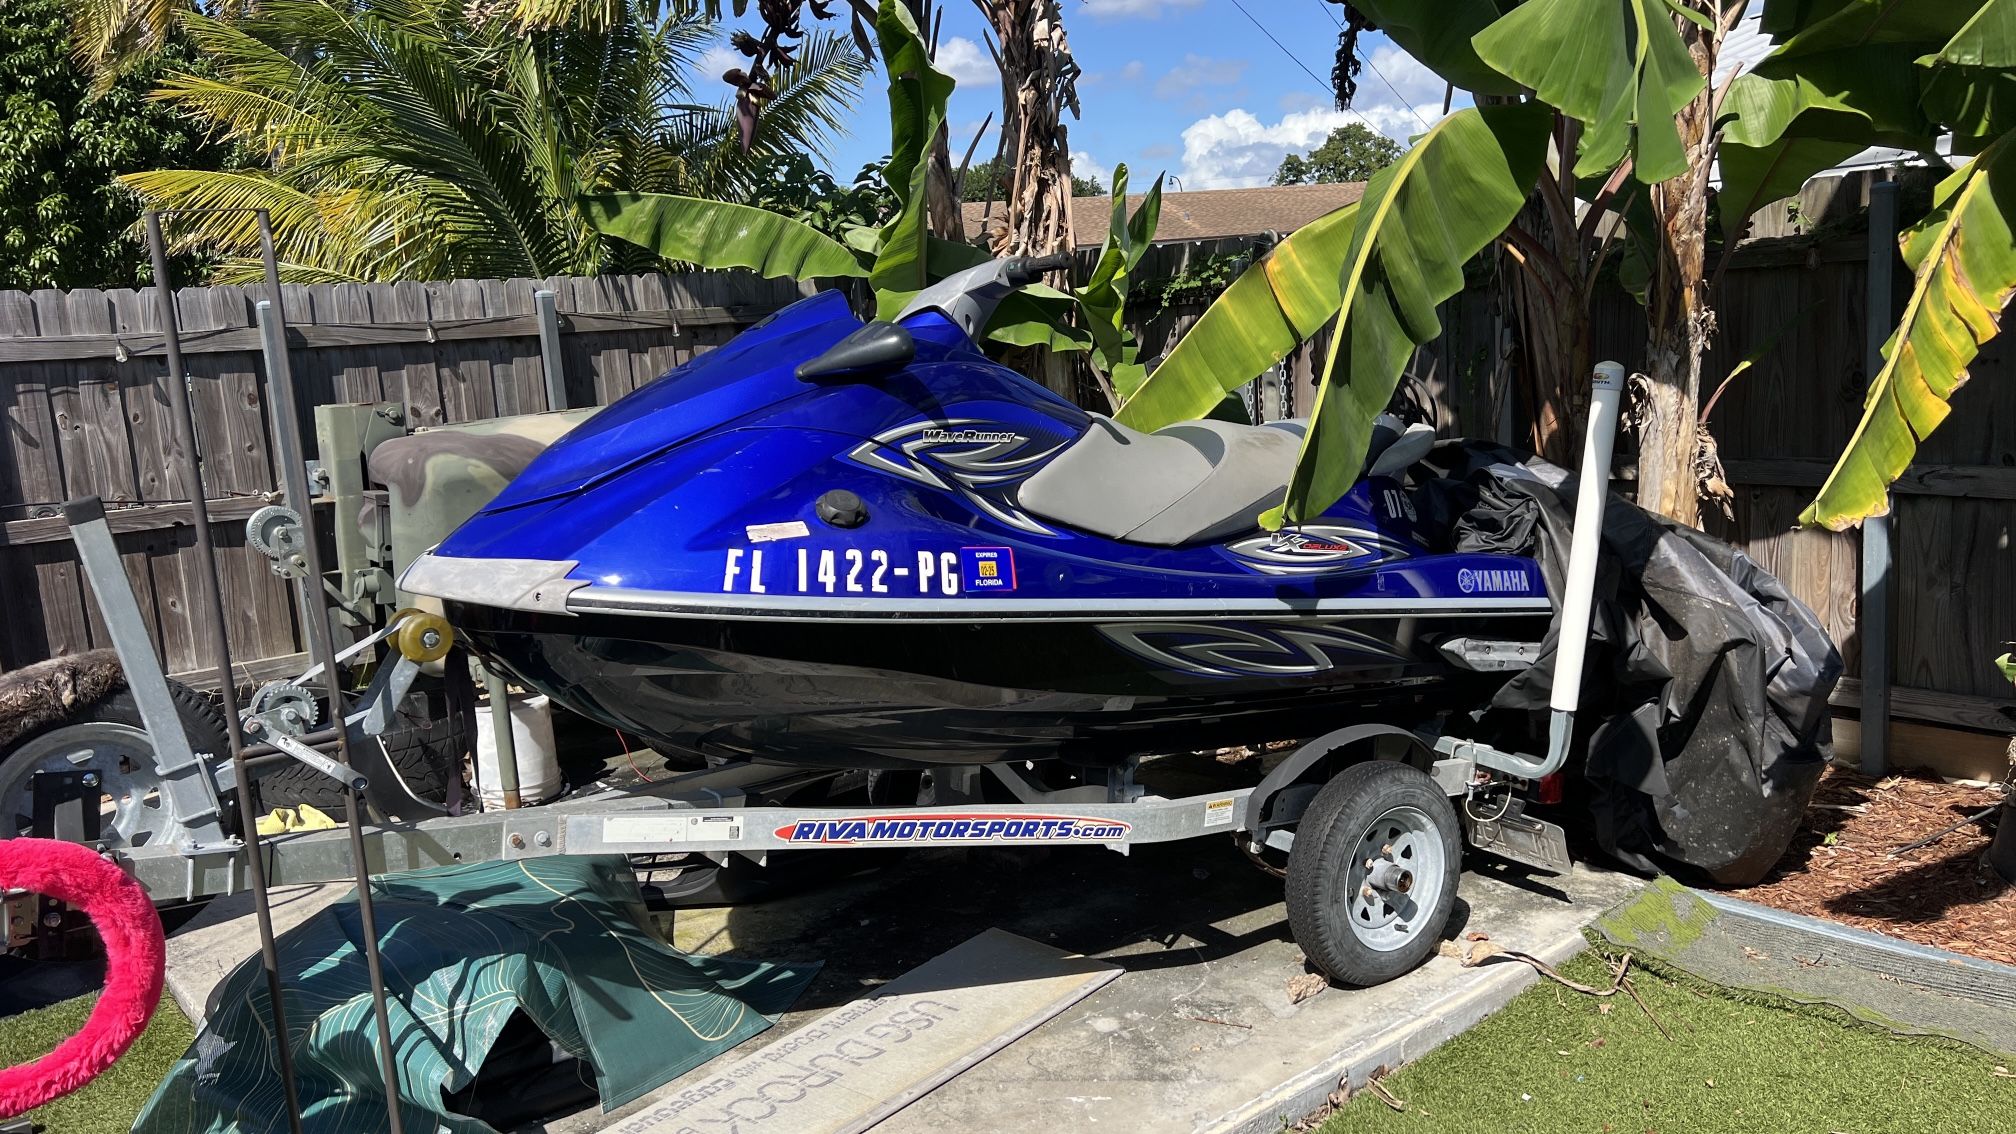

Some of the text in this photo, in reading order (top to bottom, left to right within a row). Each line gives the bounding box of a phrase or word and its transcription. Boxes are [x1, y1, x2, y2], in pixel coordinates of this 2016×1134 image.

[923, 429, 1016, 443] WaveRunner
[1270, 533, 1349, 552] VX DELUXE
[723, 549, 958, 595] FL 1422-PG
[1474, 570, 1530, 591] YAMAHA
[792, 821, 868, 840] RIVA
[761, 1029, 831, 1062] Board
[696, 1001, 960, 1134] USG DUROCK
[728, 1060, 766, 1079] with
